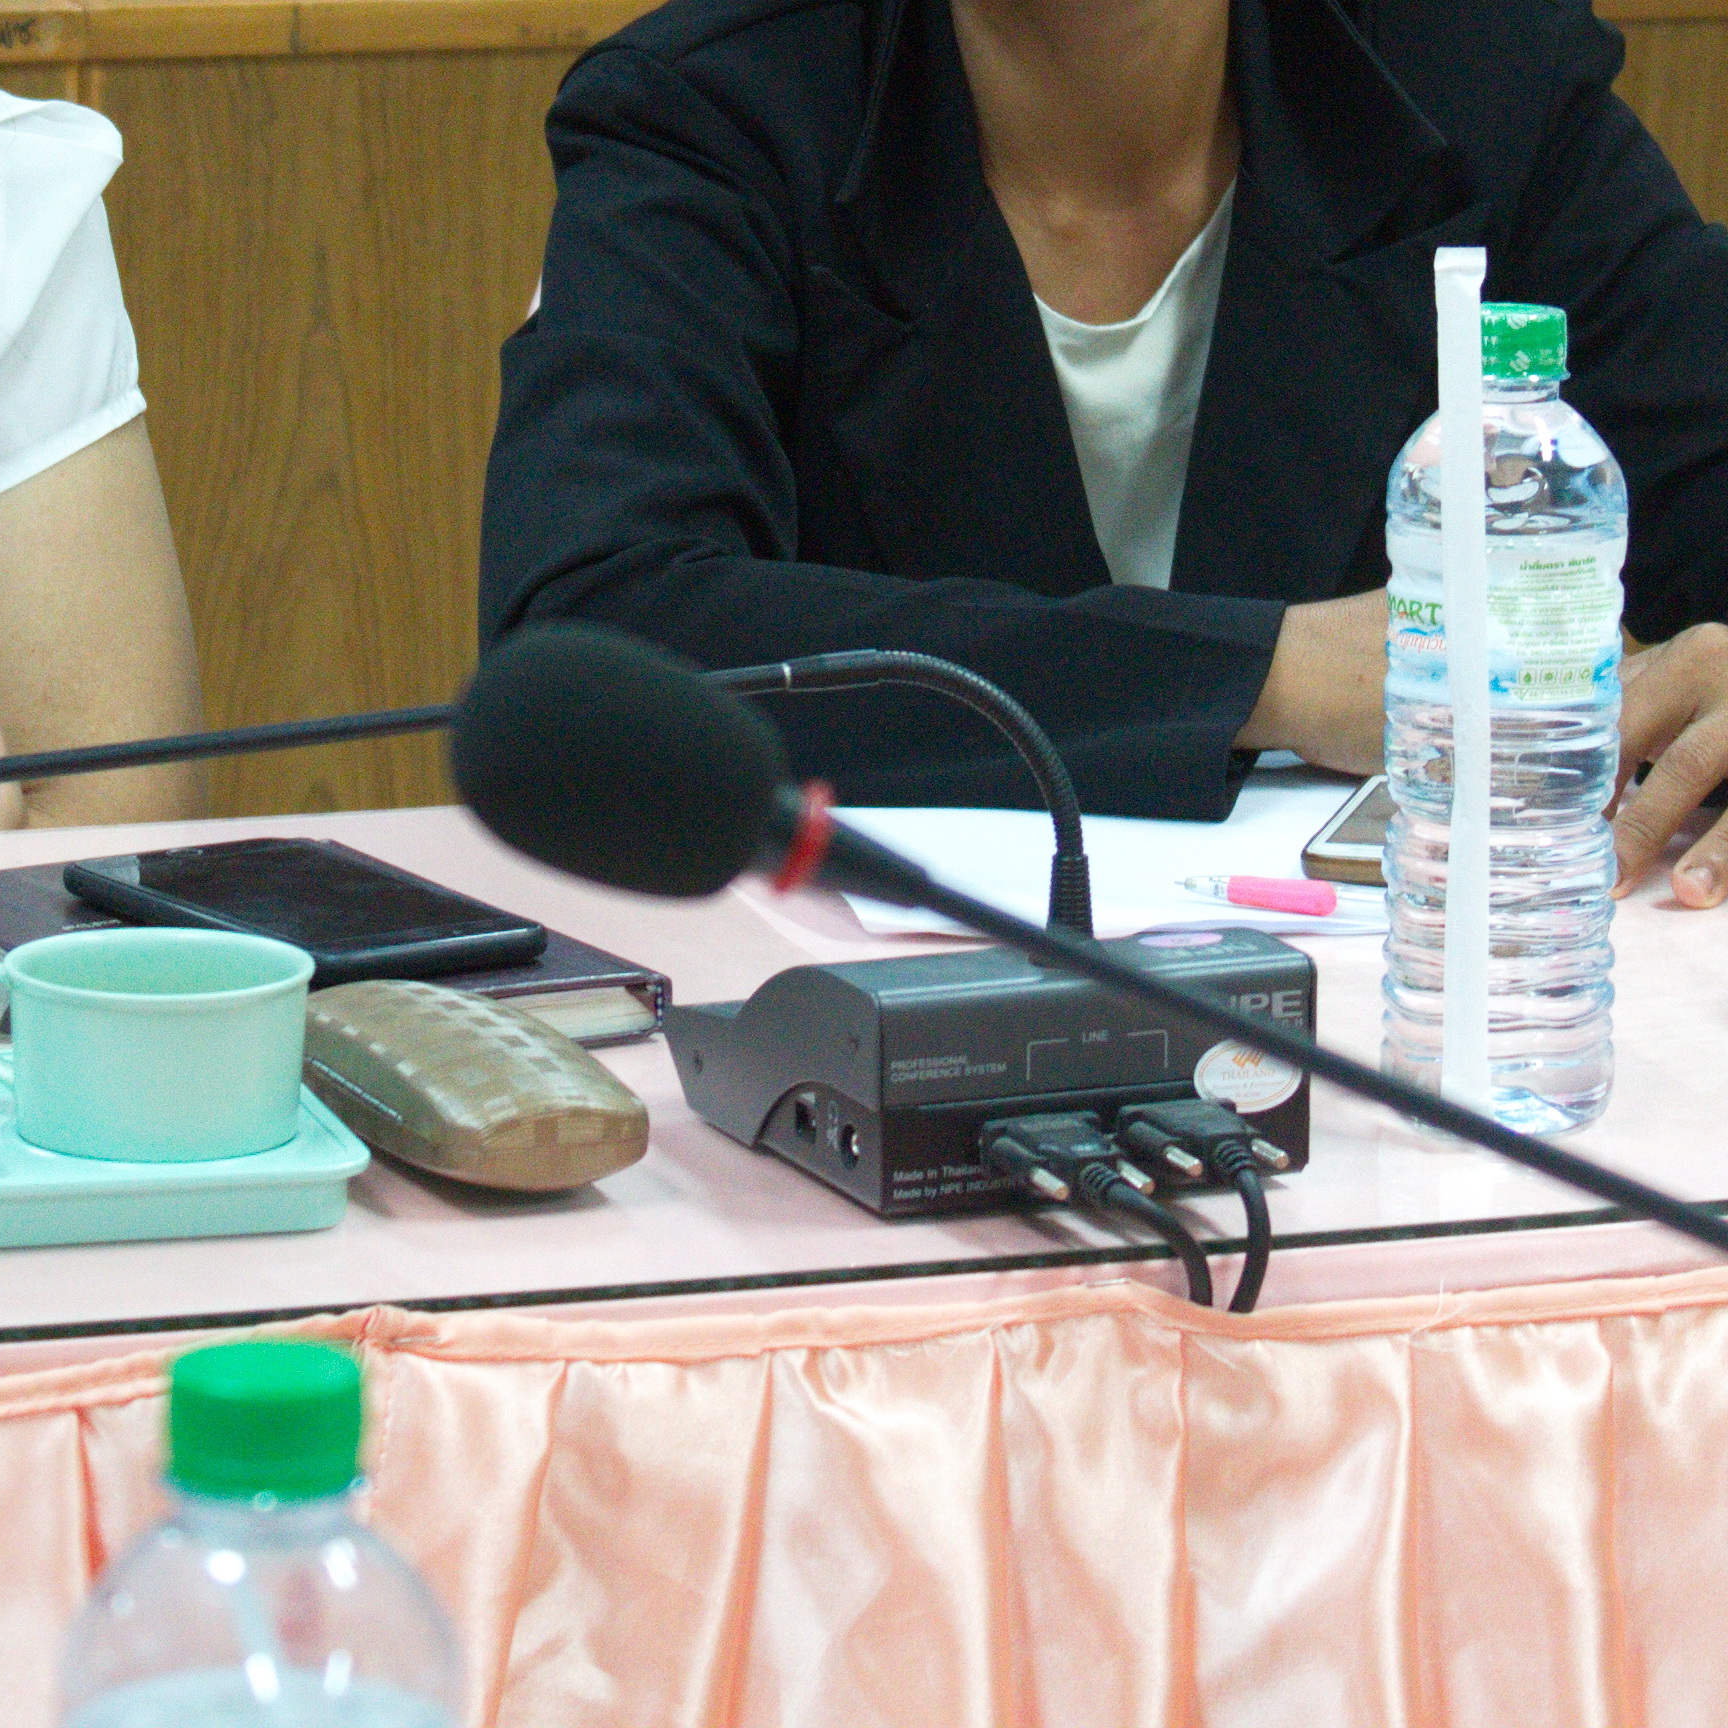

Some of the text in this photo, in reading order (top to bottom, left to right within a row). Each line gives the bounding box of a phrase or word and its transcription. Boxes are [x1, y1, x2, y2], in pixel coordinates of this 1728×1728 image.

[1082, 1029, 1109, 1044] LINE
[890, 1055, 969, 1070] PROFESSIONAL
[890, 1062, 1007, 1083] CONFERENCE SYSTEM
[1221, 1067, 1276, 1081] THAILAND
[893, 1170, 924, 1182] Made
[893, 1188, 922, 1200] Made
[924, 1185, 937, 1200] by
